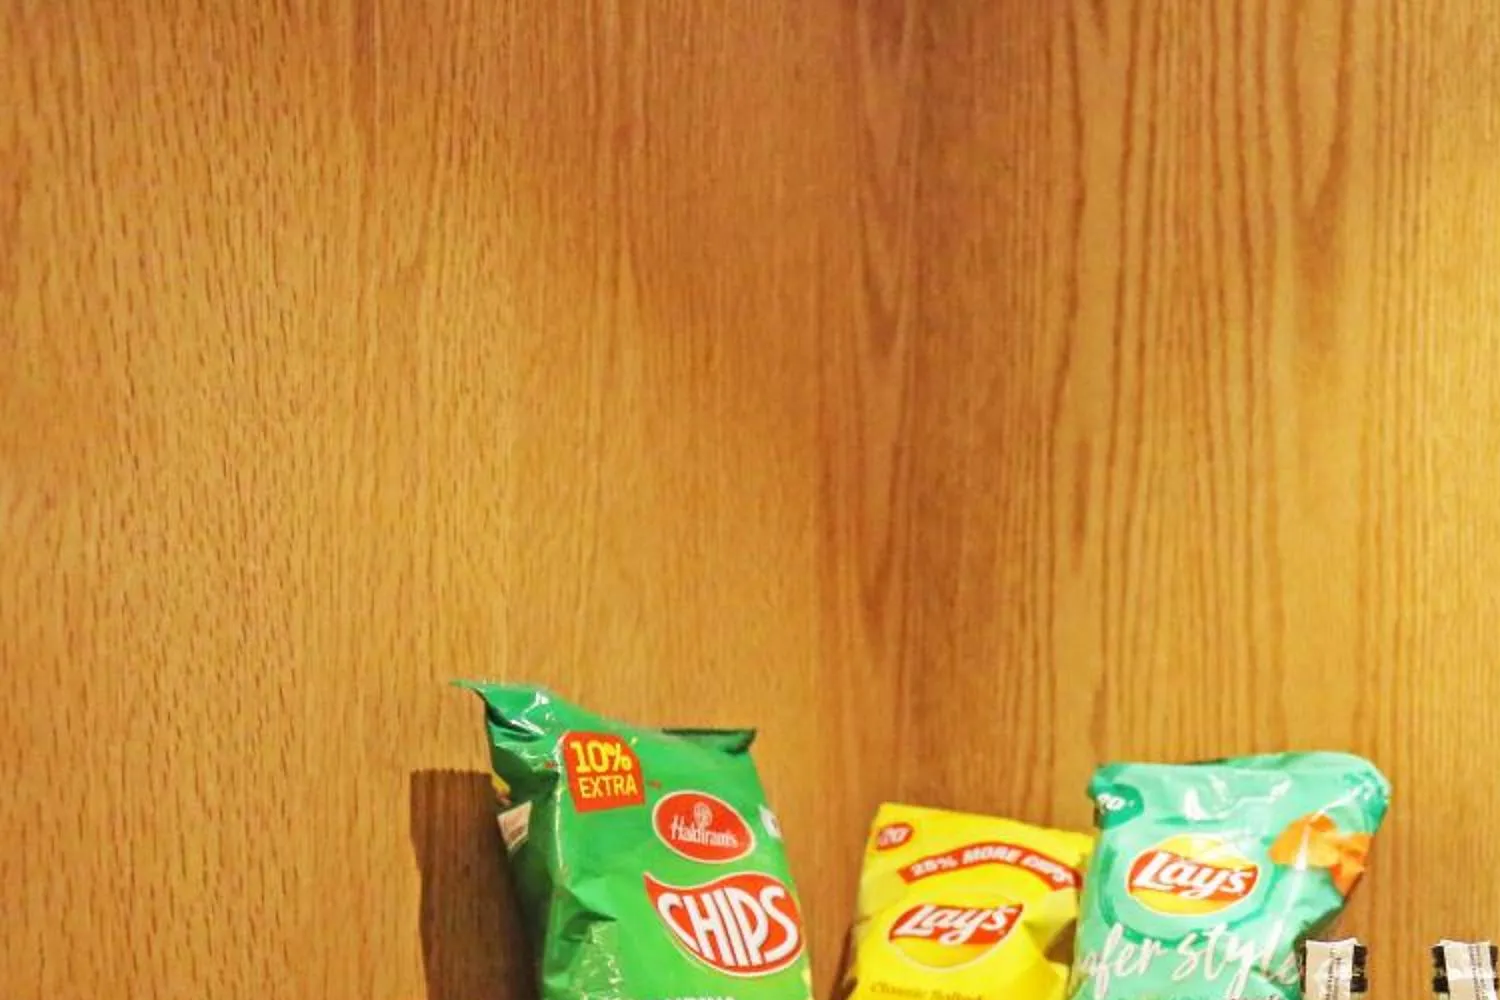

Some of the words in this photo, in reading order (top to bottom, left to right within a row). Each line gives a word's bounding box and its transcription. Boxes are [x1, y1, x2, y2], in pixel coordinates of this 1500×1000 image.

[570, 740, 633, 773] 10%
[577, 774, 639, 799] EXTRA
[961, 845, 1022, 866] MORE
[657, 886, 799, 967] CHIPS
